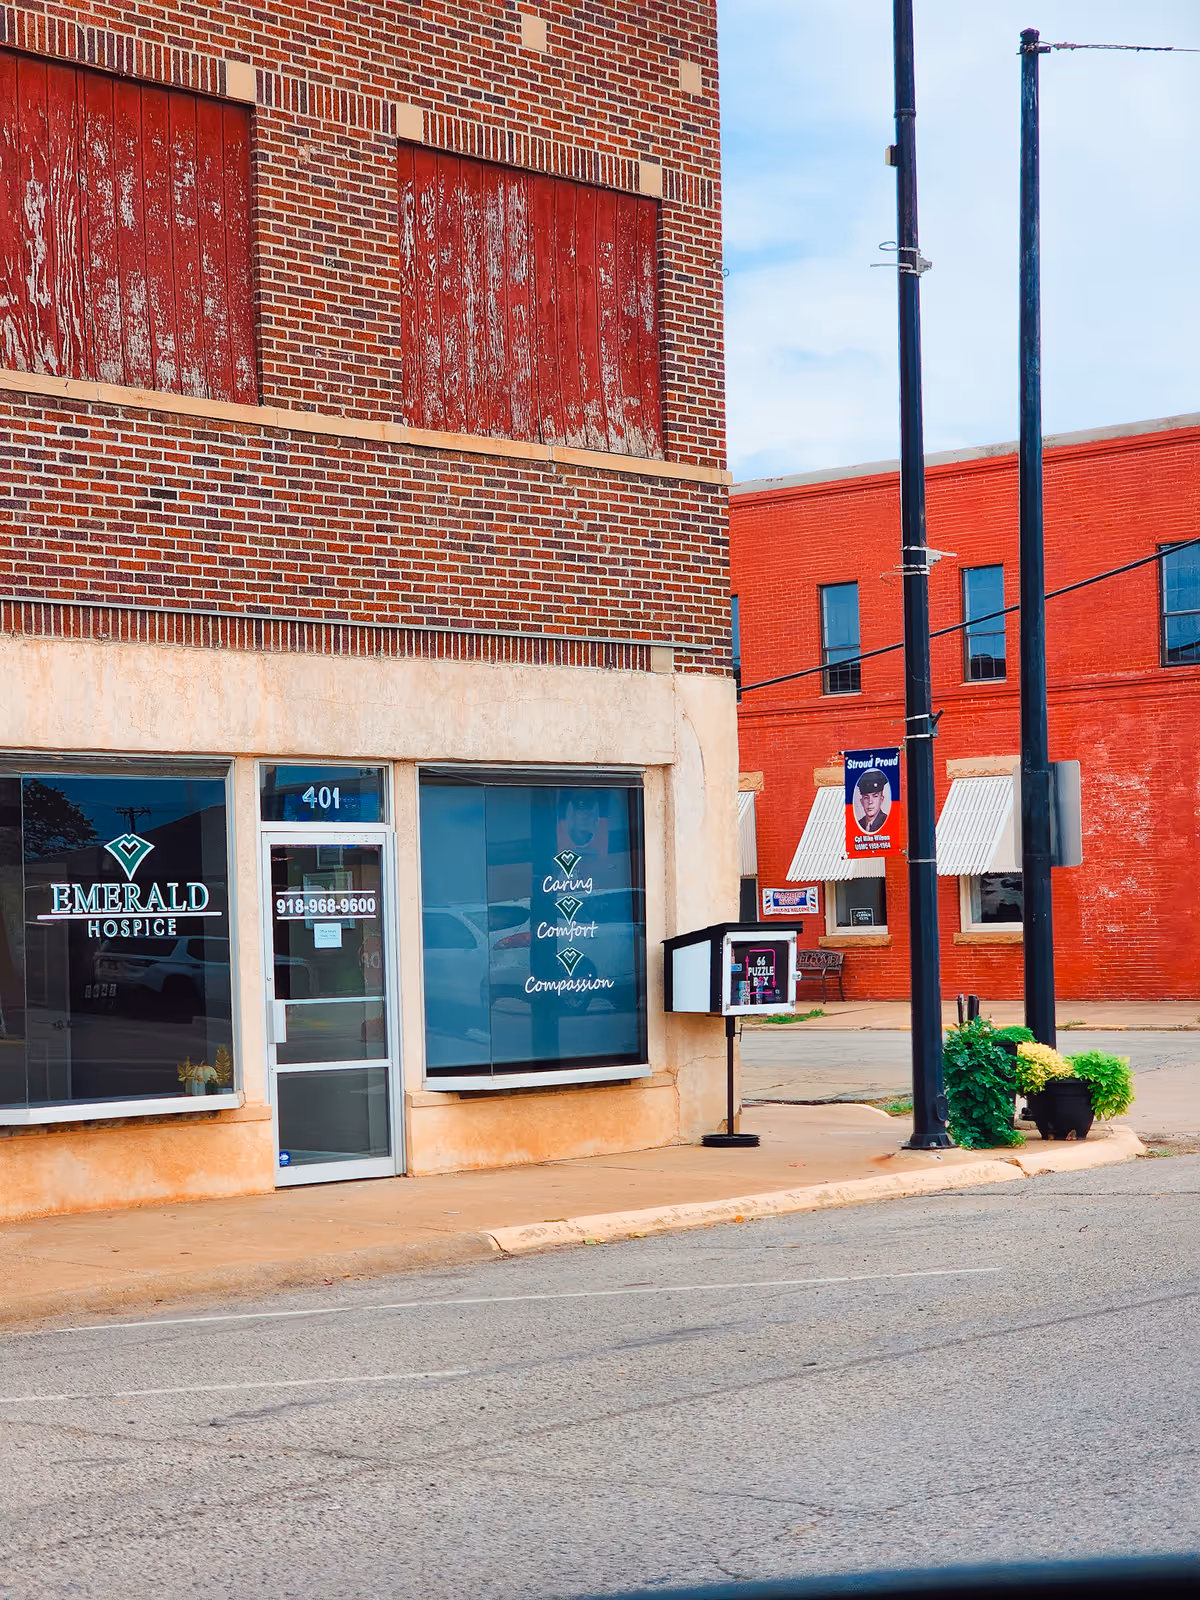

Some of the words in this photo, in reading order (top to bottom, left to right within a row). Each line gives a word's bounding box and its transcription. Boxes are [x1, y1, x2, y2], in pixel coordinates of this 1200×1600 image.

[847, 757, 873, 769] Stroud
[875, 755, 898, 767] Proud
[302, 785, 340, 809] 401
[542, 873, 593, 894] Caring
[50, 882, 210, 914] EMERALD
[276, 898, 376, 914] 918-968-9600
[87, 918, 177, 938] HOSPICE
[537, 920, 599, 942] Comfort
[747, 966, 775, 976] PUZZLE
[756, 956, 766, 966] 66
[525, 974, 614, 996] Compassion
